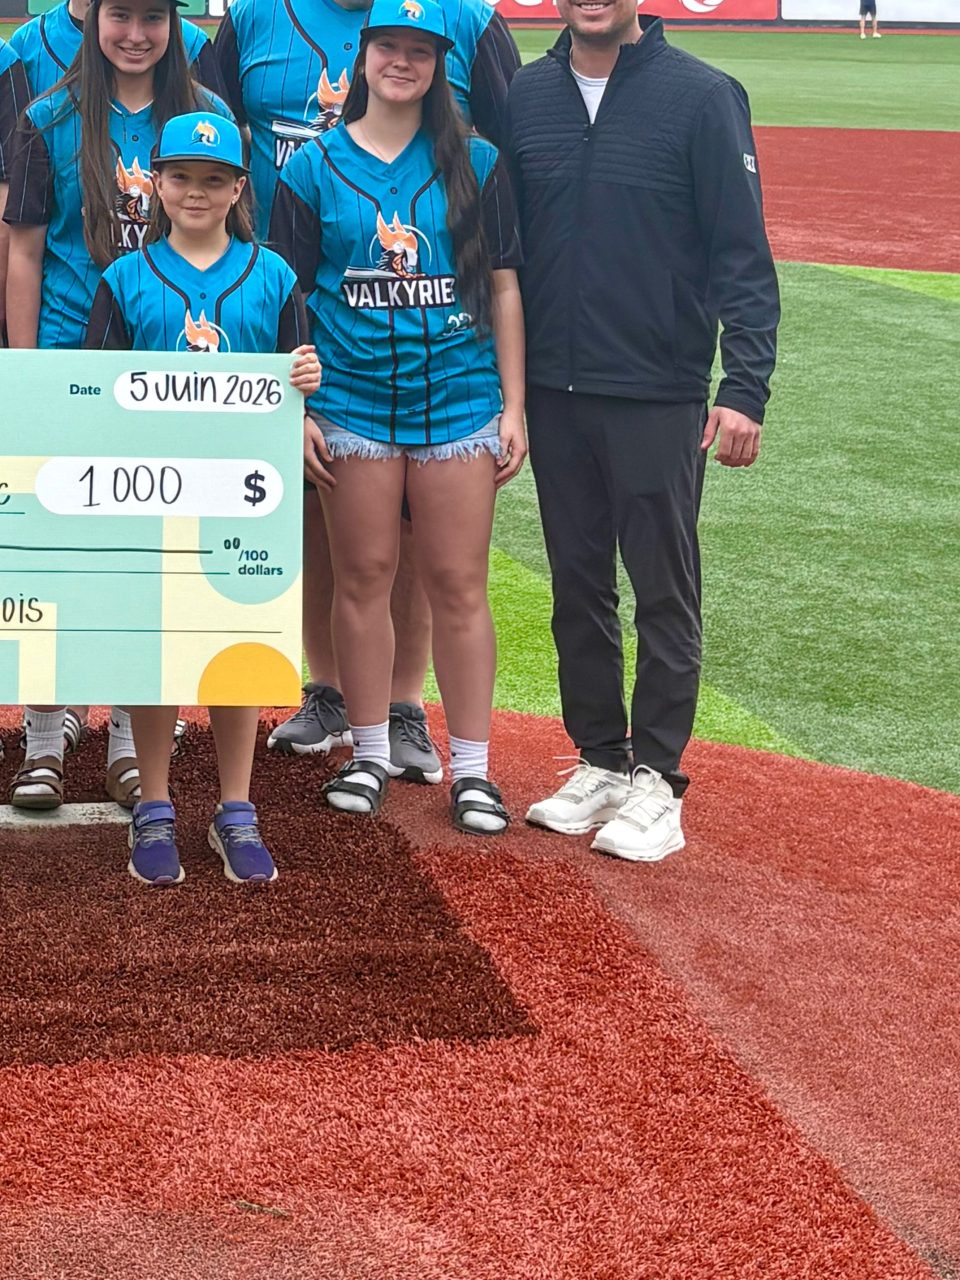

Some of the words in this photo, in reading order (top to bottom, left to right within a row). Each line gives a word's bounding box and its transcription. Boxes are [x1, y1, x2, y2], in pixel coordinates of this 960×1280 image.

[69, 384, 102, 396] Date
[130, 371, 149, 402] 5
[222, 374, 282, 406] 2026
[243, 469, 267, 508] $
[238, 550, 269, 563] /100
[237, 564, 284, 576] dollars
